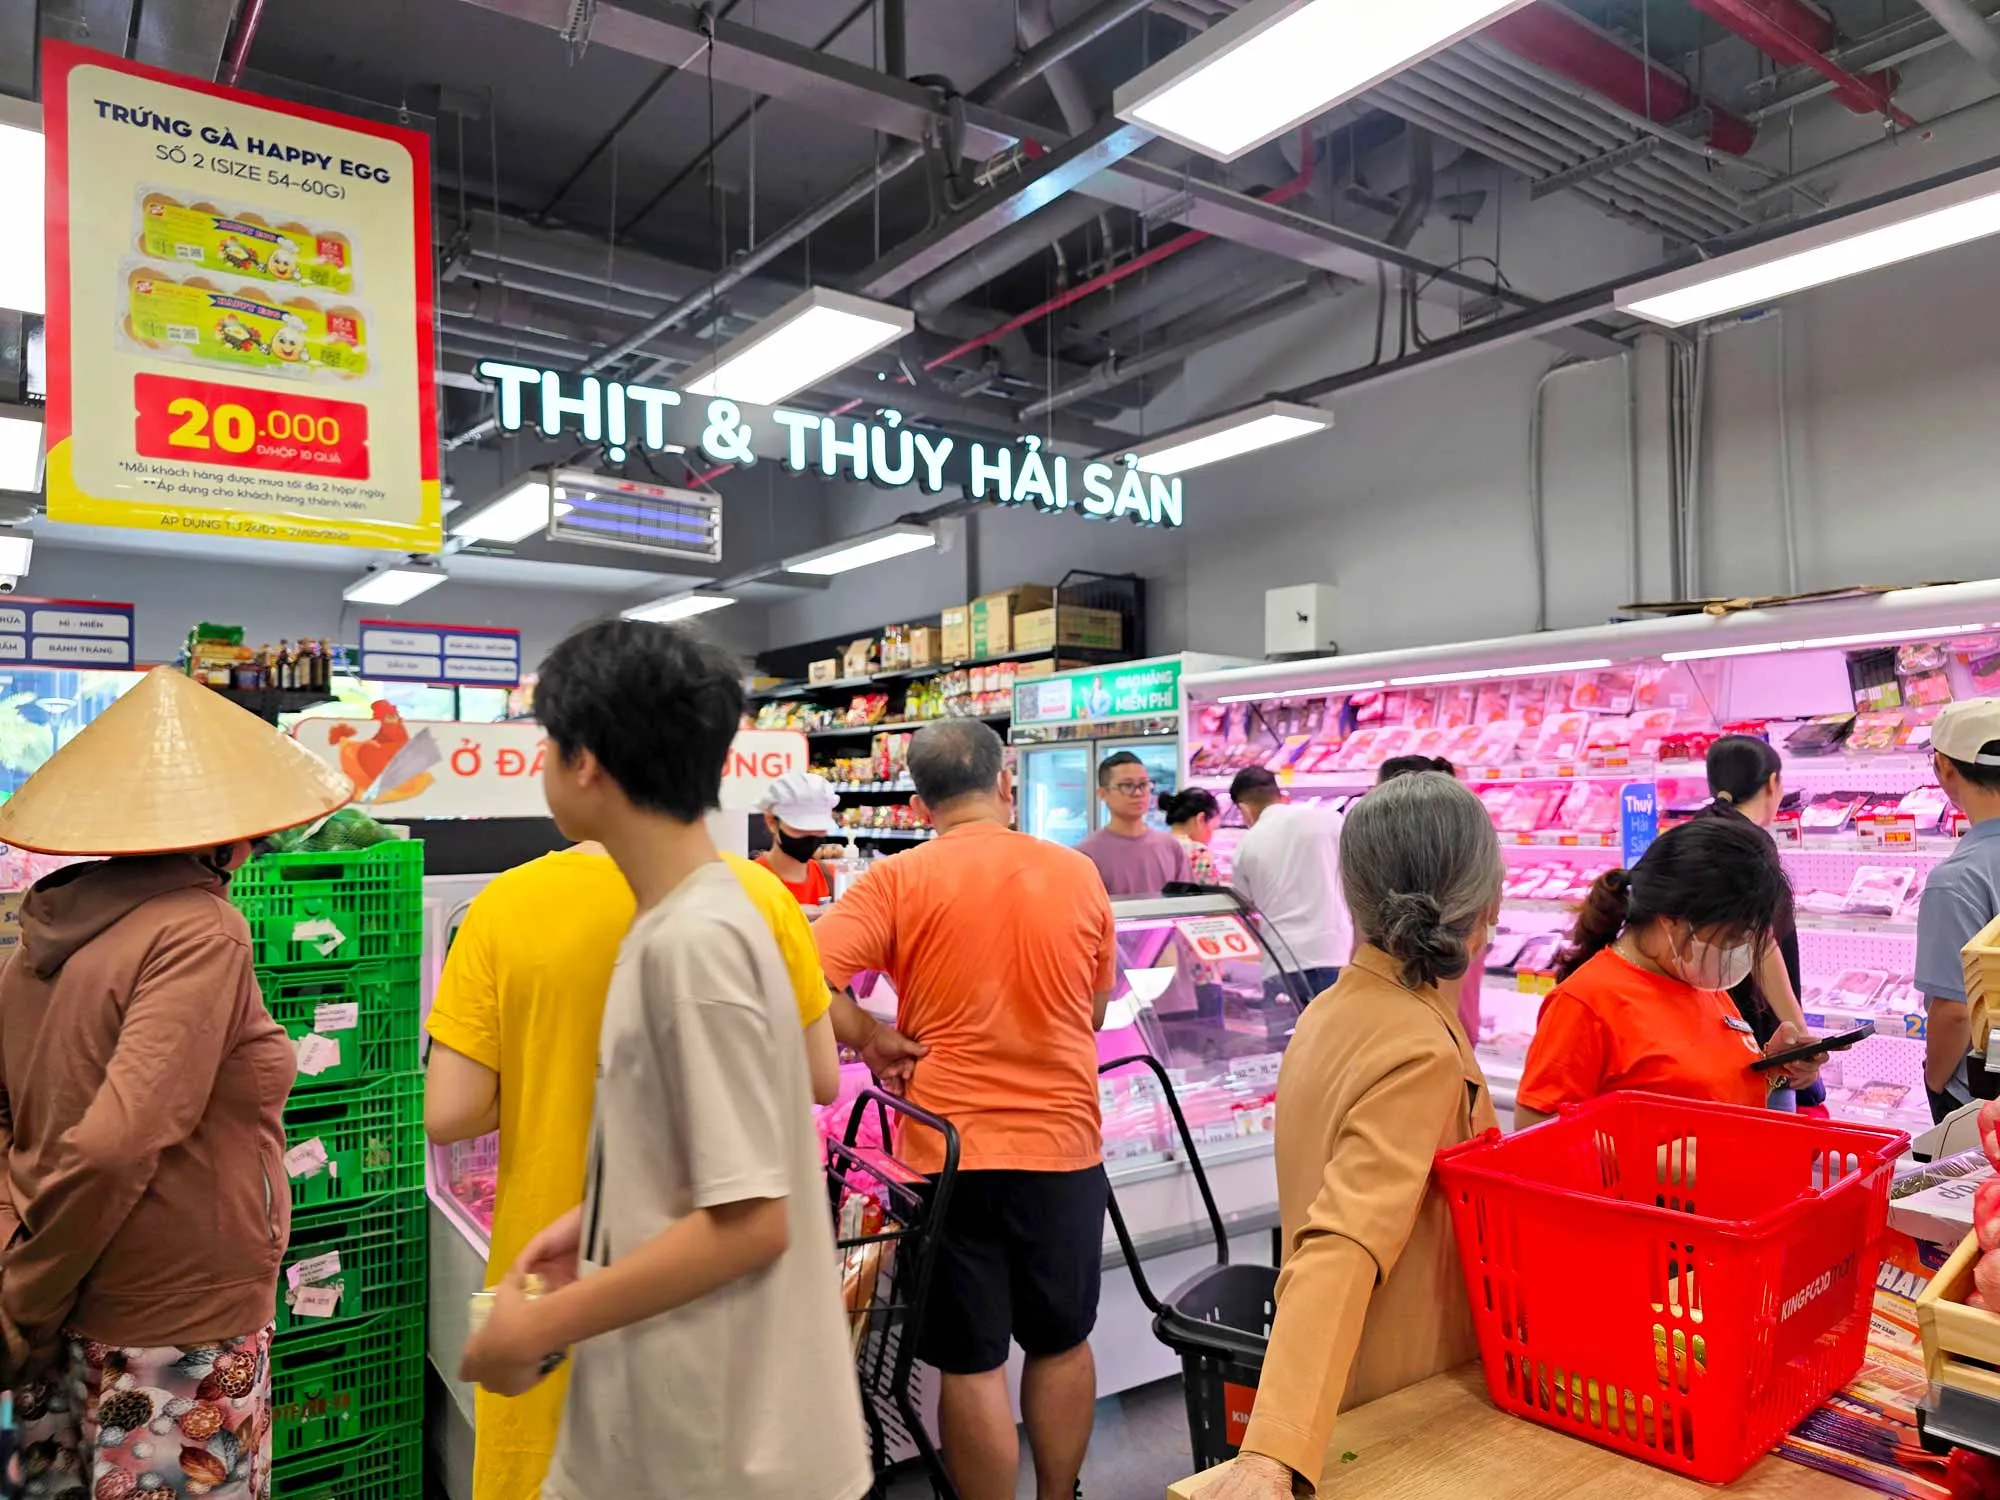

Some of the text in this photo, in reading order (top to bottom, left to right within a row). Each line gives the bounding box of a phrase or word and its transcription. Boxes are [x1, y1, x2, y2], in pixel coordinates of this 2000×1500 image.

[94, 99, 391, 184] TRỨNG GÀ HAPPY EGG
[155, 143, 187, 164] SỐ
[193, 153, 205, 169] 2
[211, 156, 261, 182] (SIZE
[167, 397, 340, 454] 20.000
[300, 450, 312, 460] 10
[479, 360, 1182, 527] THỊT & THỦY HẢI SẢN
[152, 465, 190, 478] khách
[193, 469, 224, 484] hàng
[259, 478, 284, 487] mua
[305, 481, 319, 491] đa
[321, 483, 329, 491] 2
[360, 487, 386, 499] ngày
[178, 483, 209, 497] dụng
[212, 487, 234, 497] cho
[237, 488, 274, 501] khách
[276, 492, 305, 507] hàng
[308, 496, 341, 508] thành
[182, 516, 221, 530] DỤNG
[49, 644, 78, 653] BÁNH
[1151, 687, 1174, 708] PHÍ
[450, 738, 481, 777] Ở
[1905, 1014, 1928, 1037] 2
